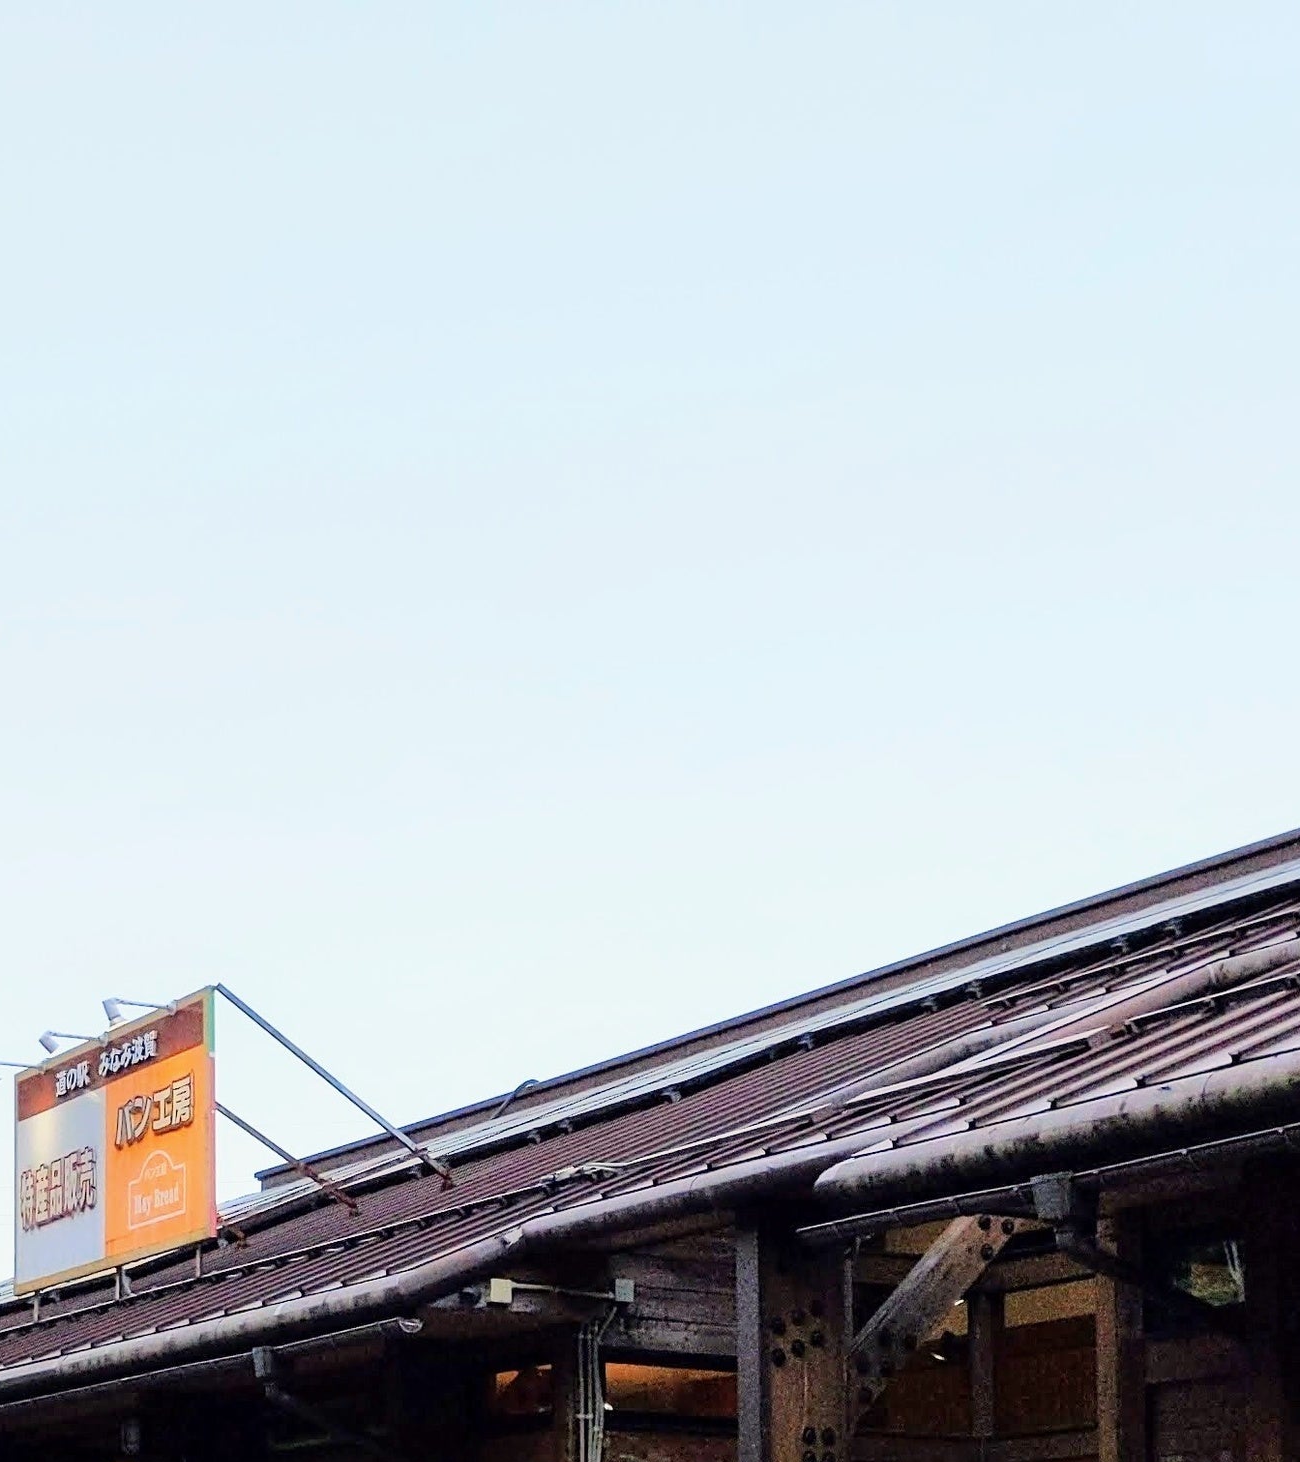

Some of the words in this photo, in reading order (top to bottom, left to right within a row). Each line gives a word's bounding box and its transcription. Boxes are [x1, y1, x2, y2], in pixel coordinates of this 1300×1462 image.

[55, 1061, 90, 1098] 道の駅
[98, 1030, 158, 1077] みなみ波賀
[115, 1073, 194, 1150] パン工房
[20, 1146, 97, 1231] 特産品販売
